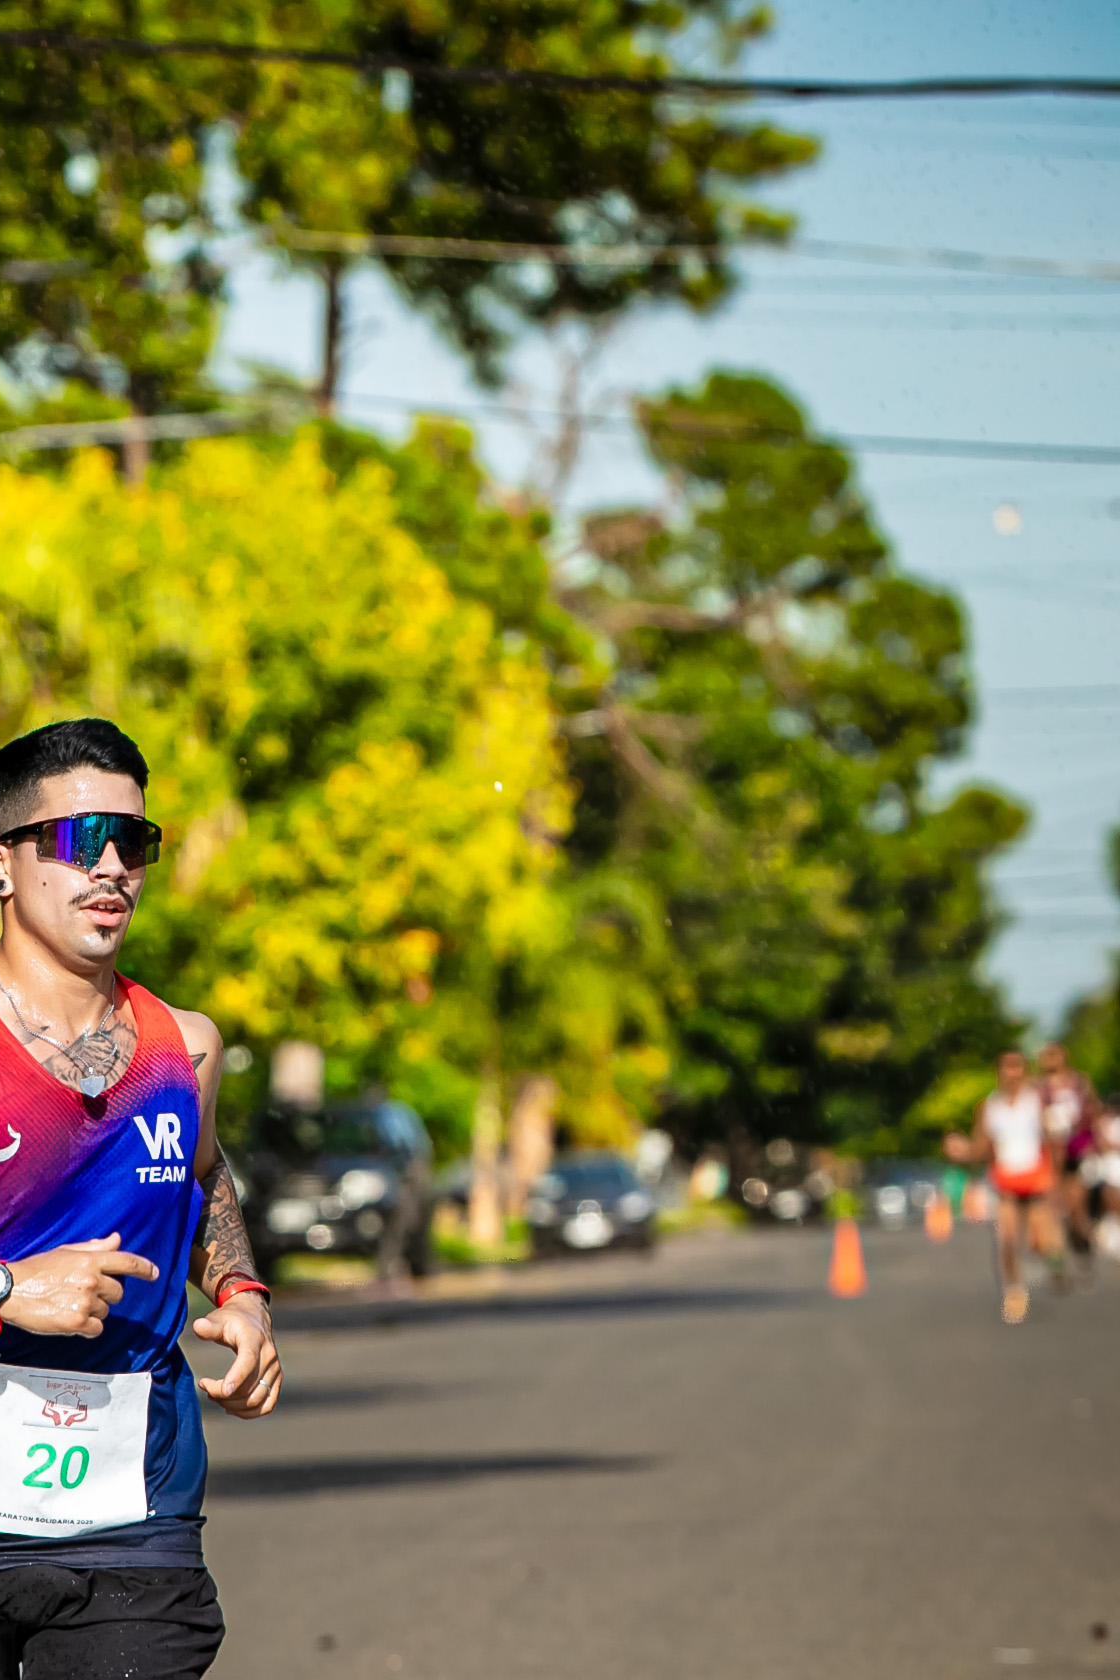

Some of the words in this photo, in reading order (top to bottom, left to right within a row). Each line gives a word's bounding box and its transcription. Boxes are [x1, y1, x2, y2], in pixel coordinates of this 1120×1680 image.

[132, 1112, 185, 1160] VR
[135, 1165, 186, 1184] TEAM
[22, 1442, 90, 1490] 20
[35, 1516, 76, 1525] SOLIDARIA
